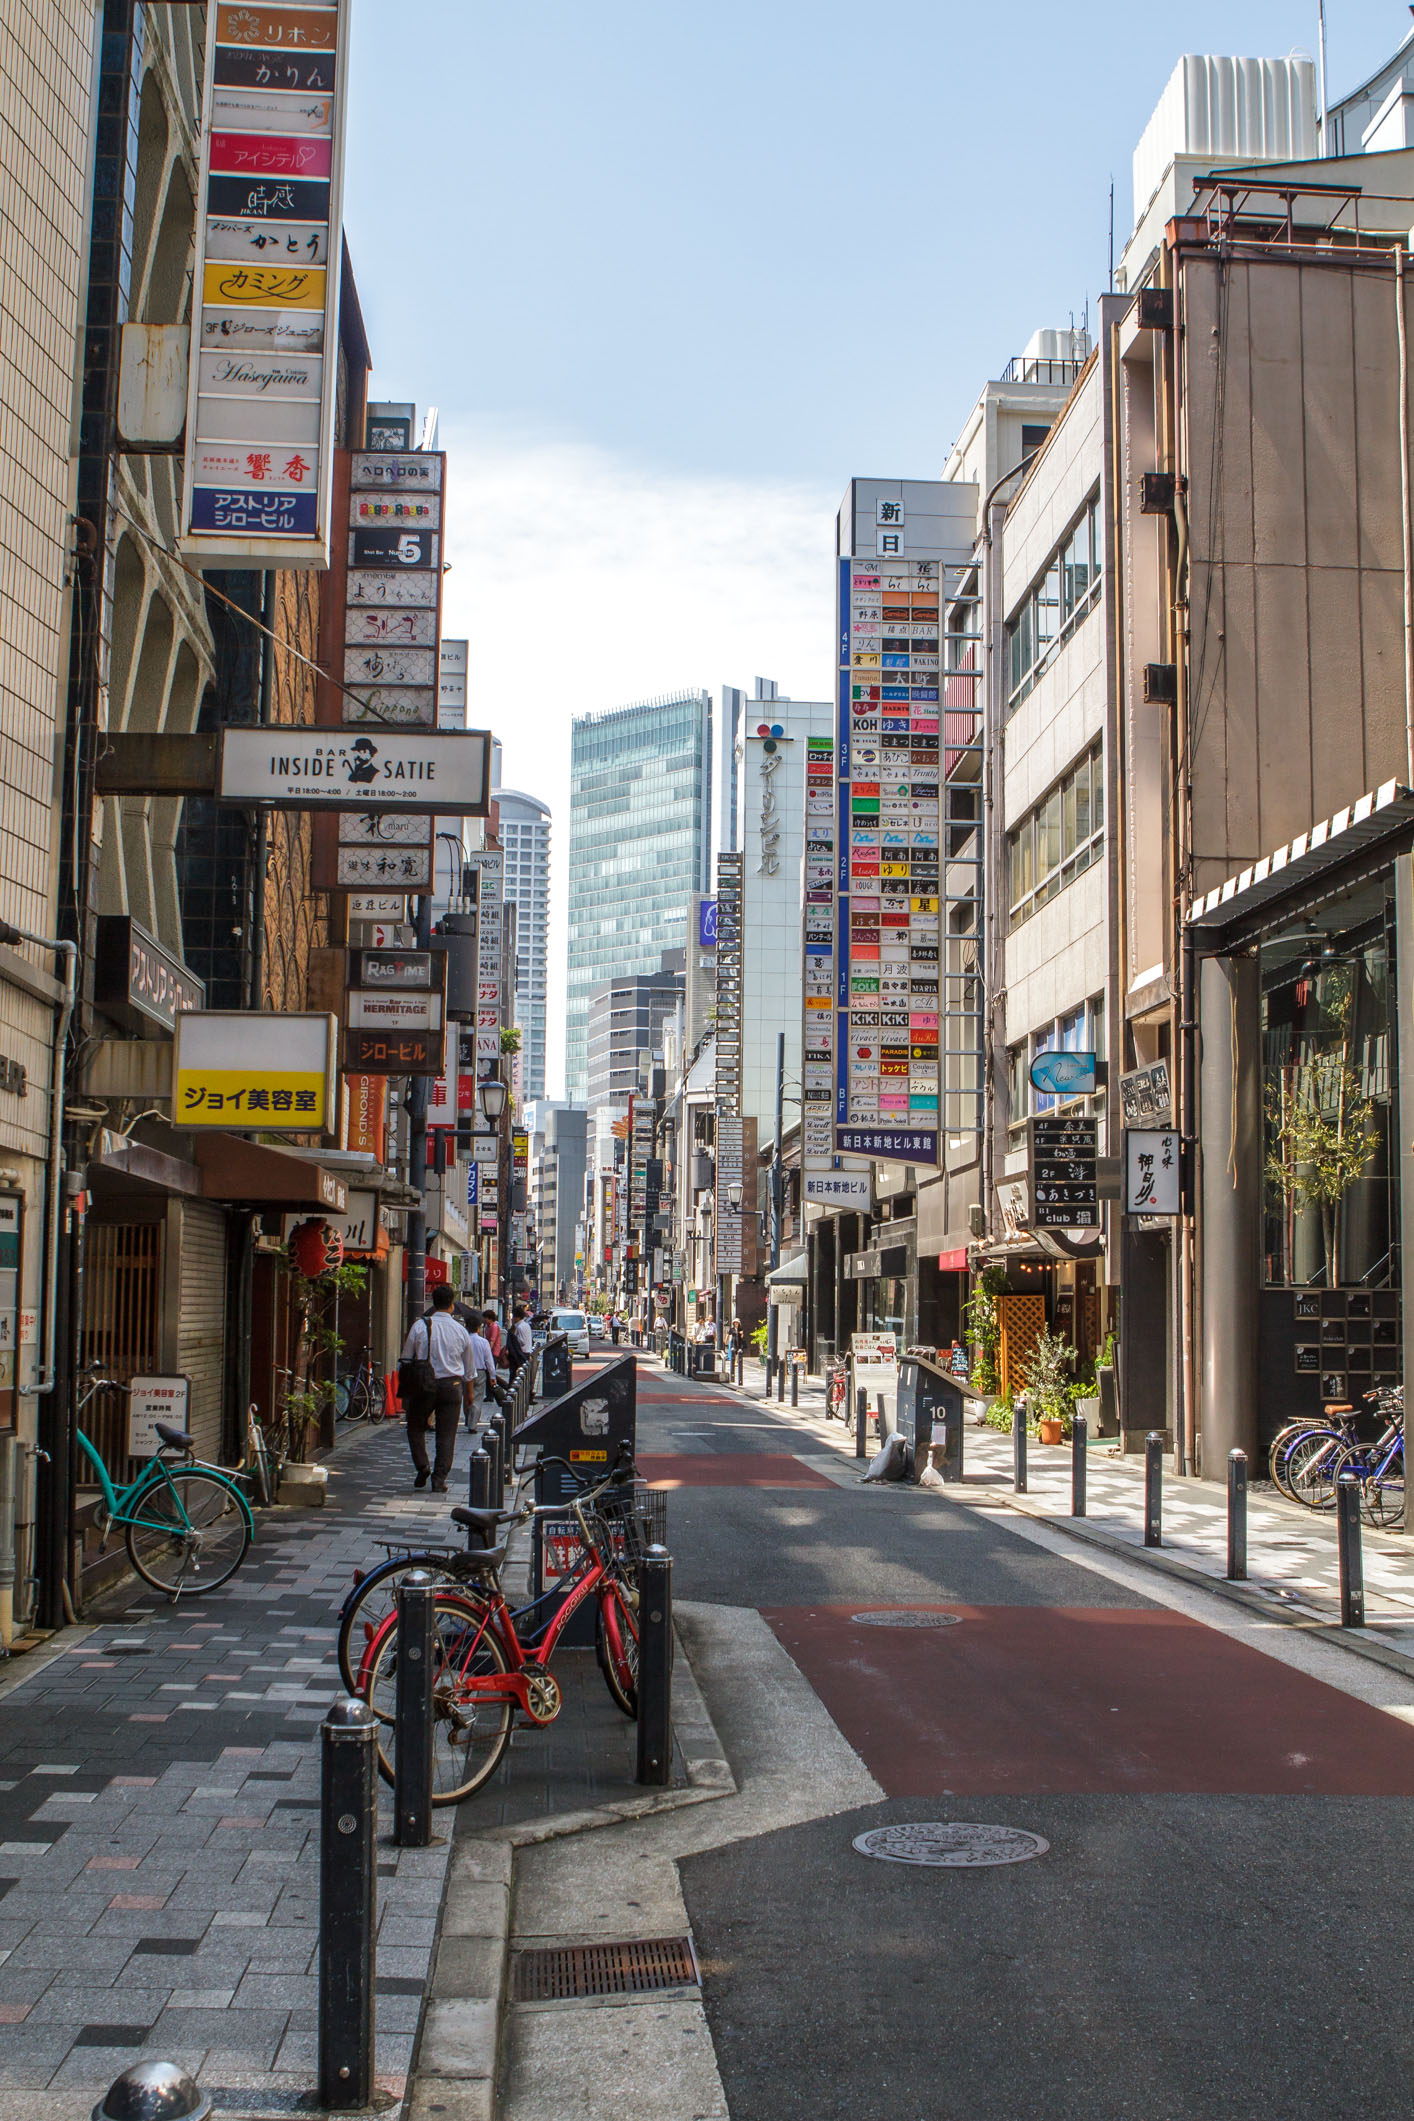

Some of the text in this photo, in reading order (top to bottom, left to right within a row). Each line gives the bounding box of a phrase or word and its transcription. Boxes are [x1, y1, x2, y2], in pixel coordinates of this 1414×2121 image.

[255, 64, 326, 88] かりん
[211, 223, 254, 234] メンバーズ
[250, 234, 319, 260] かとう
[205, 323, 218, 334] 3F
[213, 360, 308, 392] Hasegawa
[215, 494, 296, 511] アストリア
[360, 503, 429, 517] Ragga Ragga
[215, 511, 294, 528] ジロービル
[398, 534, 421, 564] 5
[913, 627, 933, 635] BAR
[853, 720, 877, 731] KOH
[883, 738, 908, 746] こまつ
[316, 748, 346, 756] BAR
[271, 756, 436, 780] INSIDE SATIE
[883, 964, 907, 975] 月波
[852, 983, 877, 992] FOLK
[912, 985, 937, 993] MARIA
[363, 1005, 427, 1014] HERMITAGE
[852, 1014, 878, 1024] KiKi
[882, 1014, 908, 1025] KiKi
[361, 1042, 426, 1061] ジロービル
[881, 1065, 908, 1073] トッケビ
[184, 1087, 317, 1112] ジョイ美容室
[359, 1075, 369, 1146] GIROND'S
[843, 1135, 932, 1150] 新日本新地ビル東館
[1042, 1169, 1055, 1178] 2F
[807, 1181, 867, 1194] 新日本新地ビル
[1049, 1189, 1095, 1201] あきづき
[1046, 1214, 1071, 1222] club
[1299, 1304, 1318, 1314] JKC
[929, 1406, 946, 1419] 10
